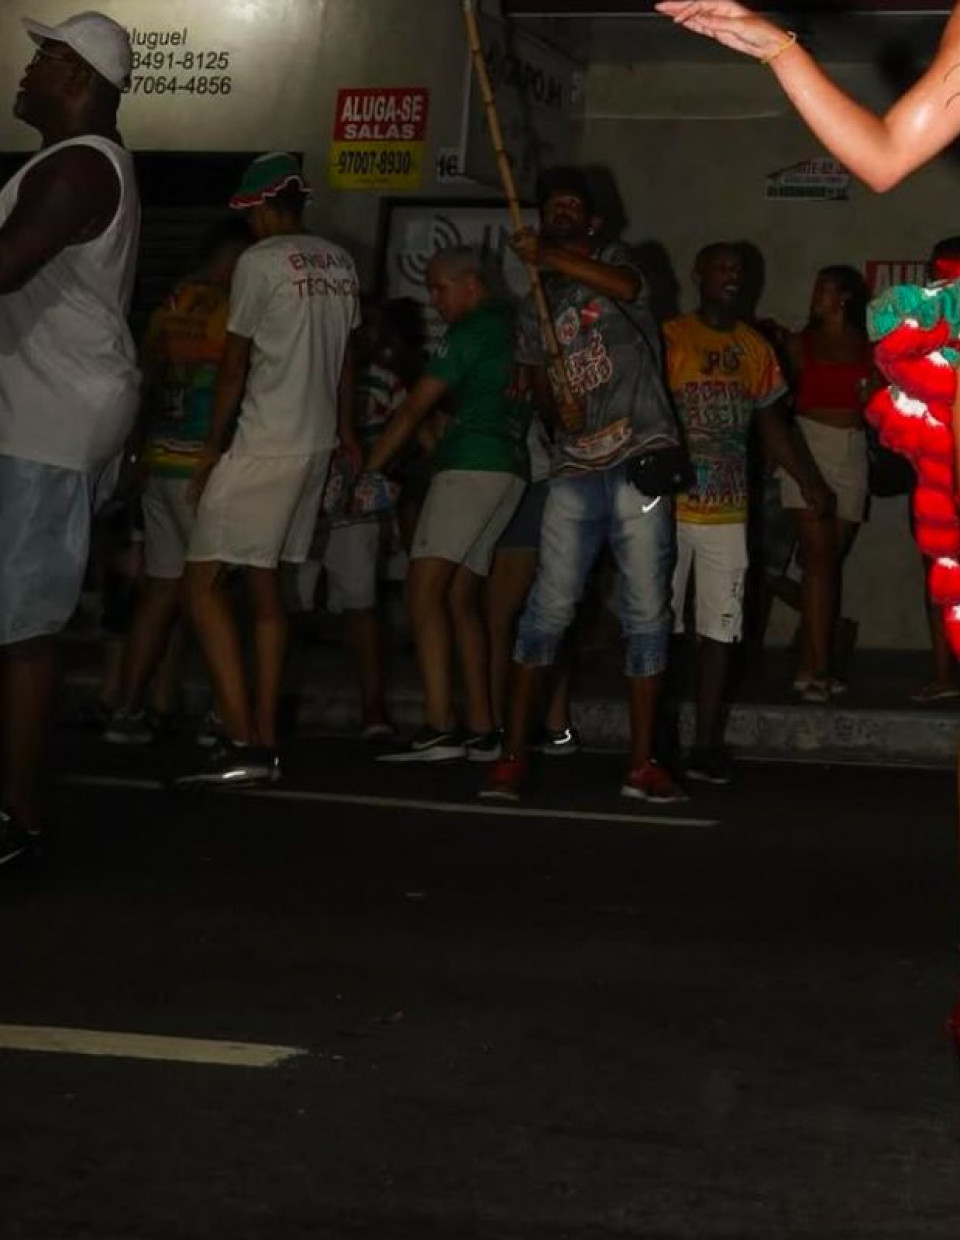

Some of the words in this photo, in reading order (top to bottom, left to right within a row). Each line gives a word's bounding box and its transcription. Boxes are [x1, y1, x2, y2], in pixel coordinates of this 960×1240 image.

[130, 27, 187, 49] luguel
[341, 94, 424, 122] ALUGA-SE
[343, 123, 416, 139] SALAS
